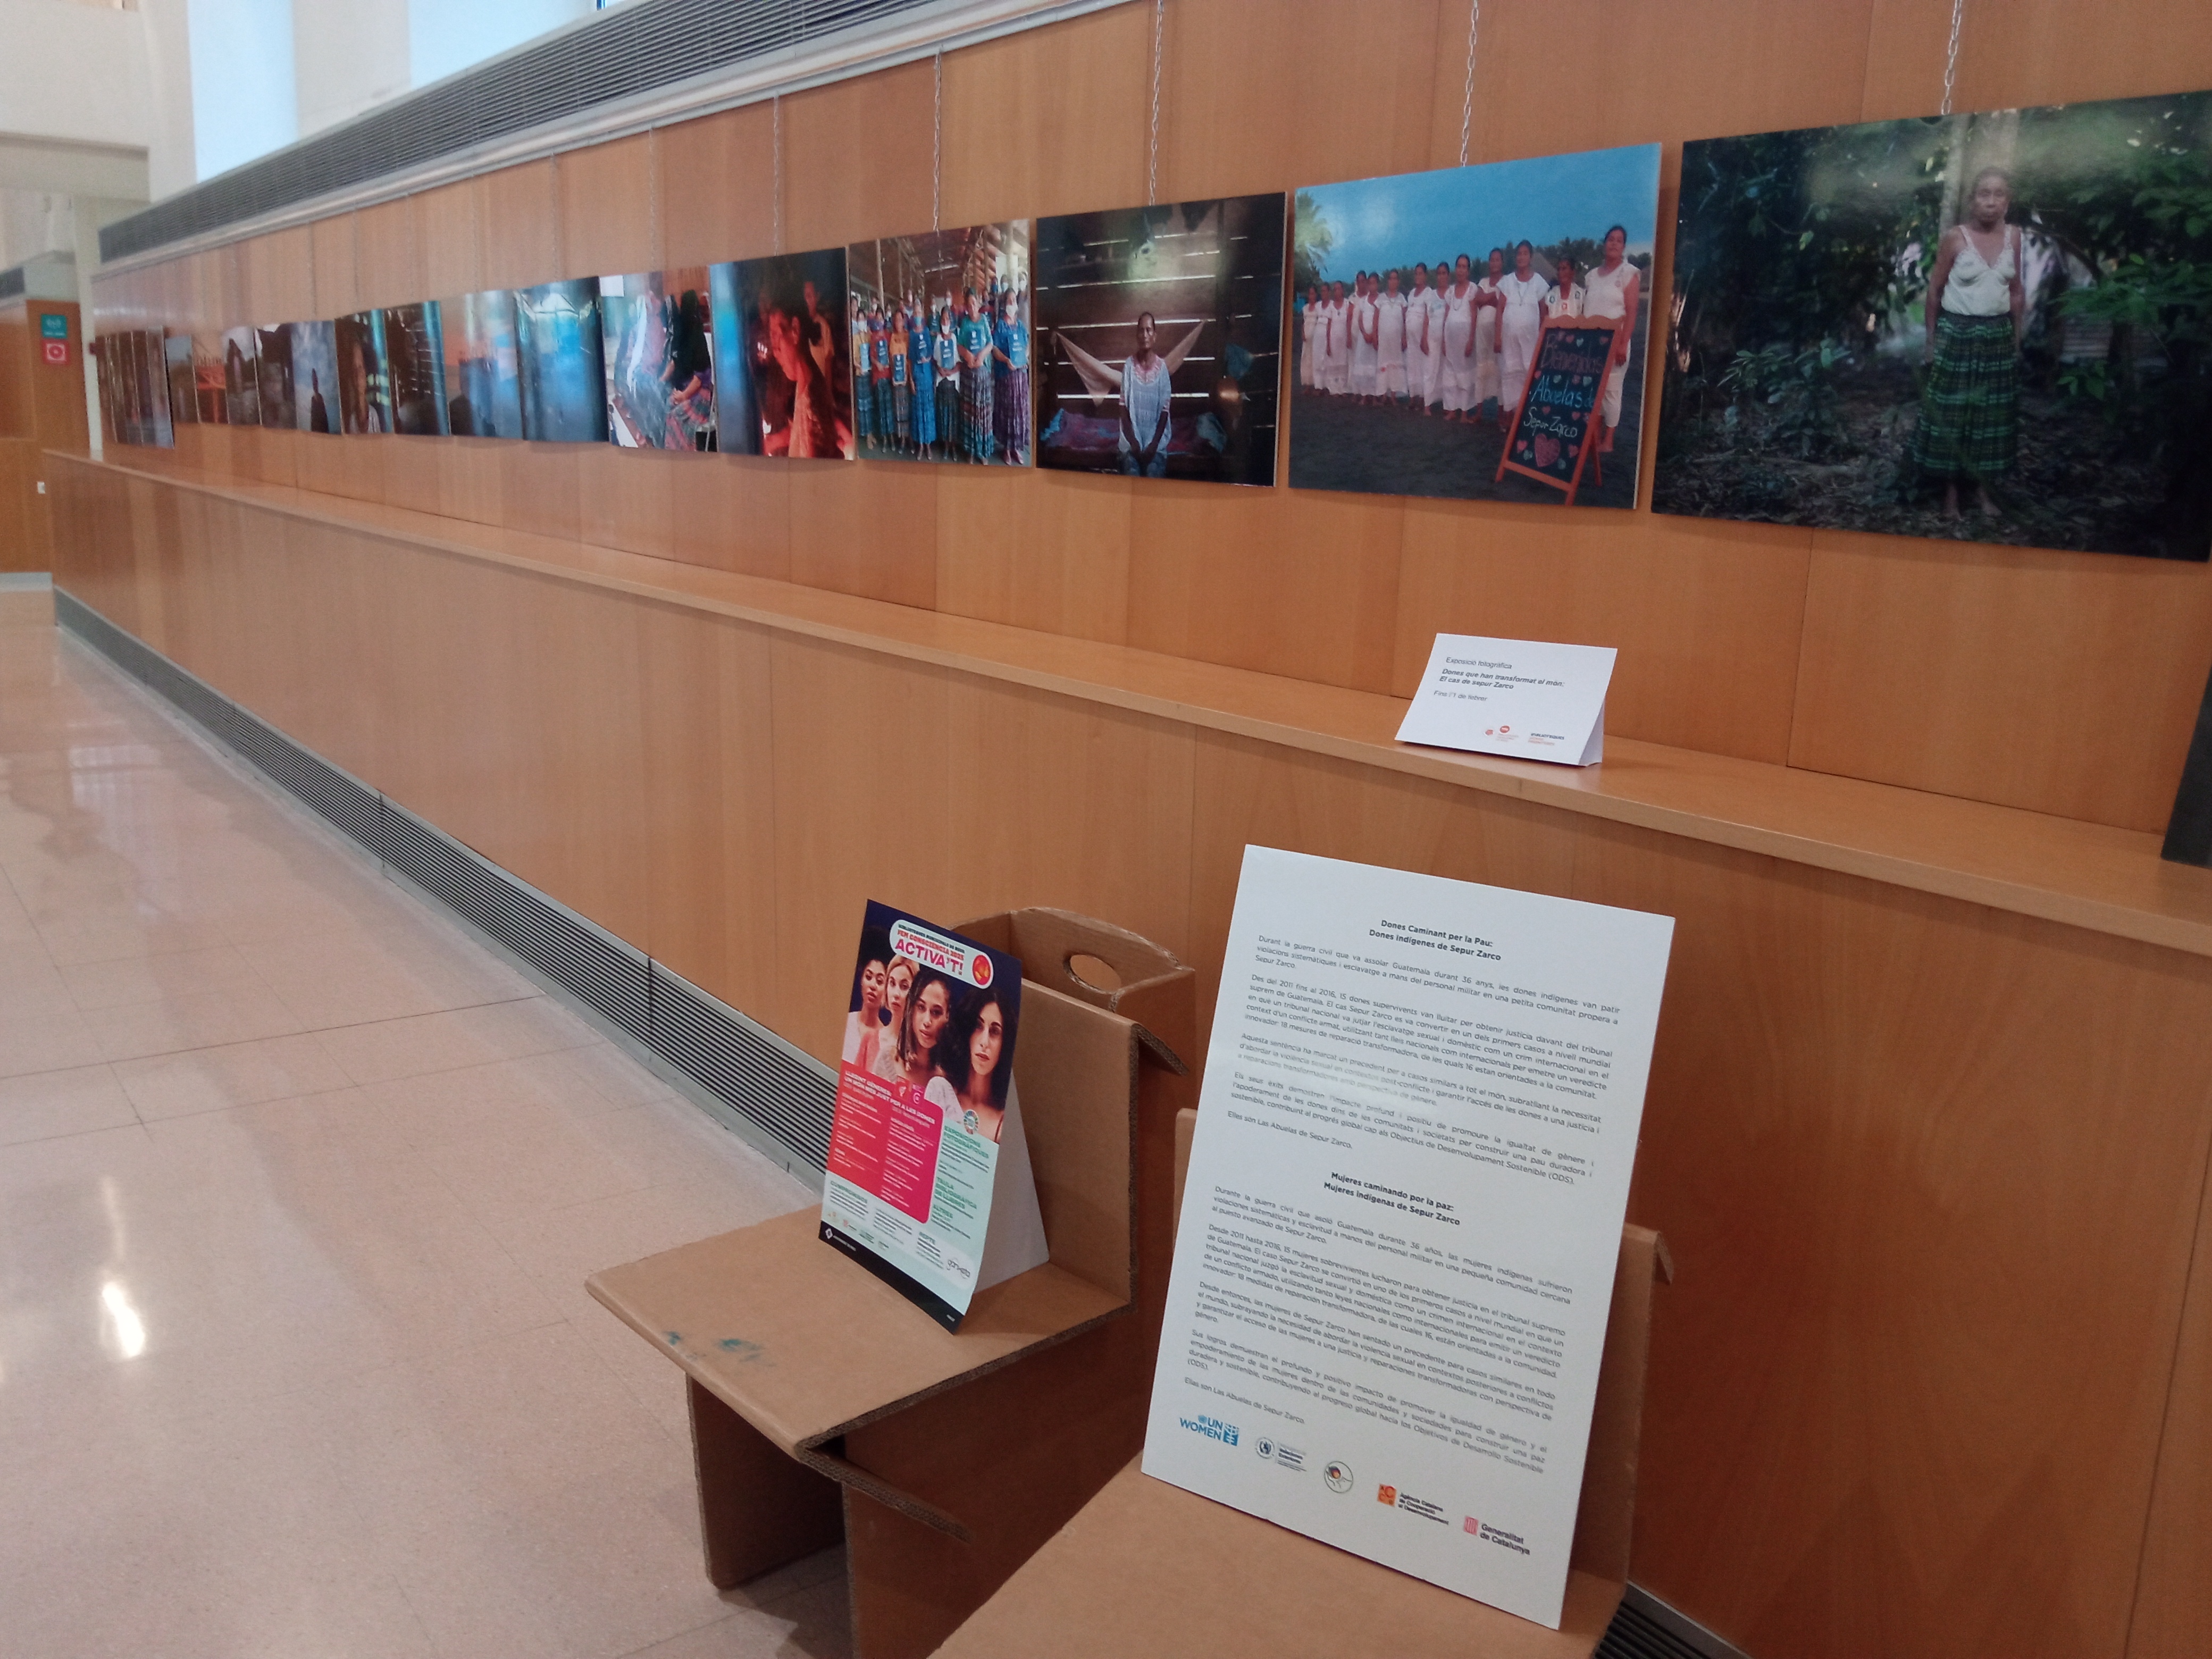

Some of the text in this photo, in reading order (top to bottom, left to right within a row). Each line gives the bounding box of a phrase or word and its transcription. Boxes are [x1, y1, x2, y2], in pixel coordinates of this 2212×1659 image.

[1531, 374, 1582, 408] Abuelas
[1524, 407, 1578, 437] Sepur Zarco
[1495, 675, 1537, 684] transformat
[1368, 928, 1394, 941] Dones
[1436, 942, 1448, 951] de
[1449, 944, 1474, 956] Sepur
[1476, 949, 1502, 961] Zarco
[1380, 919, 1406, 931] Dones
[1407, 924, 1447, 939] Caminant
[1447, 933, 1463, 942] per
[895, 939, 963, 975] ACTIVA'T!
[1254, 954, 1275, 964] Sepur
[1258, 934, 1281, 945] Durant
[1293, 943, 1316, 953] guerra
[1363, 957, 1389, 967] assolar
[1392, 961, 1431, 976] Guatemala
[1433, 970, 1459, 982] durant
[1461, 975, 1472, 984] 36
[1512, 986, 1537, 998] dones
[1581, 1001, 1597, 1010] van
[1599, 1004, 1621, 1013] patir
[1342, 963, 1380, 976] esclavatge
[1388, 973, 1408, 982] mans
[1422, 979, 1455, 991] personal
[1456, 986, 1481, 996] militar
[1494, 994, 1509, 1003] una
[1535, 1002, 1576, 1016] comunitat
[1578, 1011, 1611, 1024] propera
[1251, 973, 1264, 983] Des
[1295, 983, 1308, 992] fins
[1348, 995, 1371, 1005] dones
[1372, 1000, 1418, 1016] supervivents
[1420, 1011, 1434, 1019] van
[1475, 1022, 1504, 1034] obtenir
[1535, 1035, 1563, 1048] davant
[1565, 1041, 1579, 1050] del
[1581, 1045, 1613, 1057] tribunal
[1227, 1110, 1243, 1120] Elles
[1256, 1118, 1269, 1127] Las
[1270, 1121, 1297, 1135] Abuelas
[1309, 1131, 1329, 1142] Sepur
[1330, 1171, 1362, 1187] Mujeres
[1362, 1182, 1409, 1199] caminando
[1409, 1193, 1425, 1203] por
[1323, 1181, 1354, 1196] Mujeres
[1396, 1202, 1408, 1211] de
[1409, 1204, 1434, 1219] Sepur
[1435, 1211, 1460, 1226] Zarco
[1214, 1185, 1241, 1199] Durante
[1253, 1197, 1276, 1209] guerra
[1296, 1210, 1311, 1219] que
[1336, 1220, 1374, 1237] Guatemala
[1377, 1233, 1406, 1246] durante
[1409, 1241, 1420, 1250] 36
[1447, 1252, 1459, 1261] las
[1462, 1257, 1493, 1271] mujeres
[1284, 1225, 1305, 1237] Sepur
[1178, 1417, 1222, 1440] WOMEN
[1206, 1417, 1224, 1431] UN
[1479, 1531, 1531, 1557] de Catalunya
[1480, 1523, 1524, 1545] Generalitat
